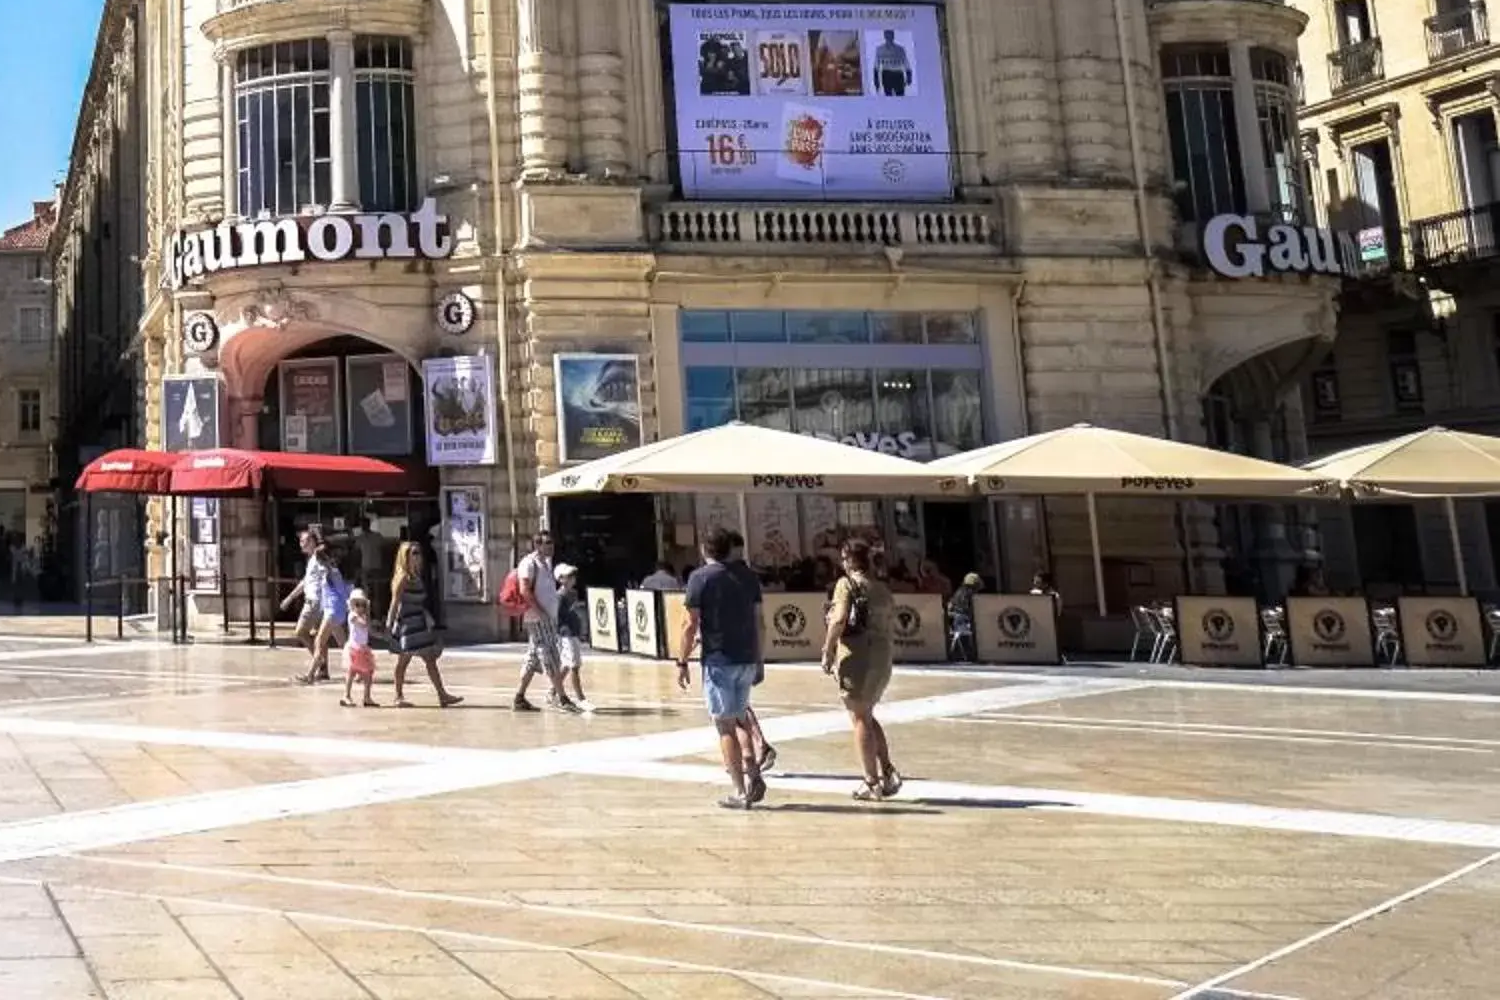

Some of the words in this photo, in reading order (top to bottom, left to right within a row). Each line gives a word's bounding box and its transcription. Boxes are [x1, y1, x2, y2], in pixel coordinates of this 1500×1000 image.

[759, 42, 801, 84] SOLO
[705, 134, 736, 165] 16
[171, 197, 451, 291] Gaumont
